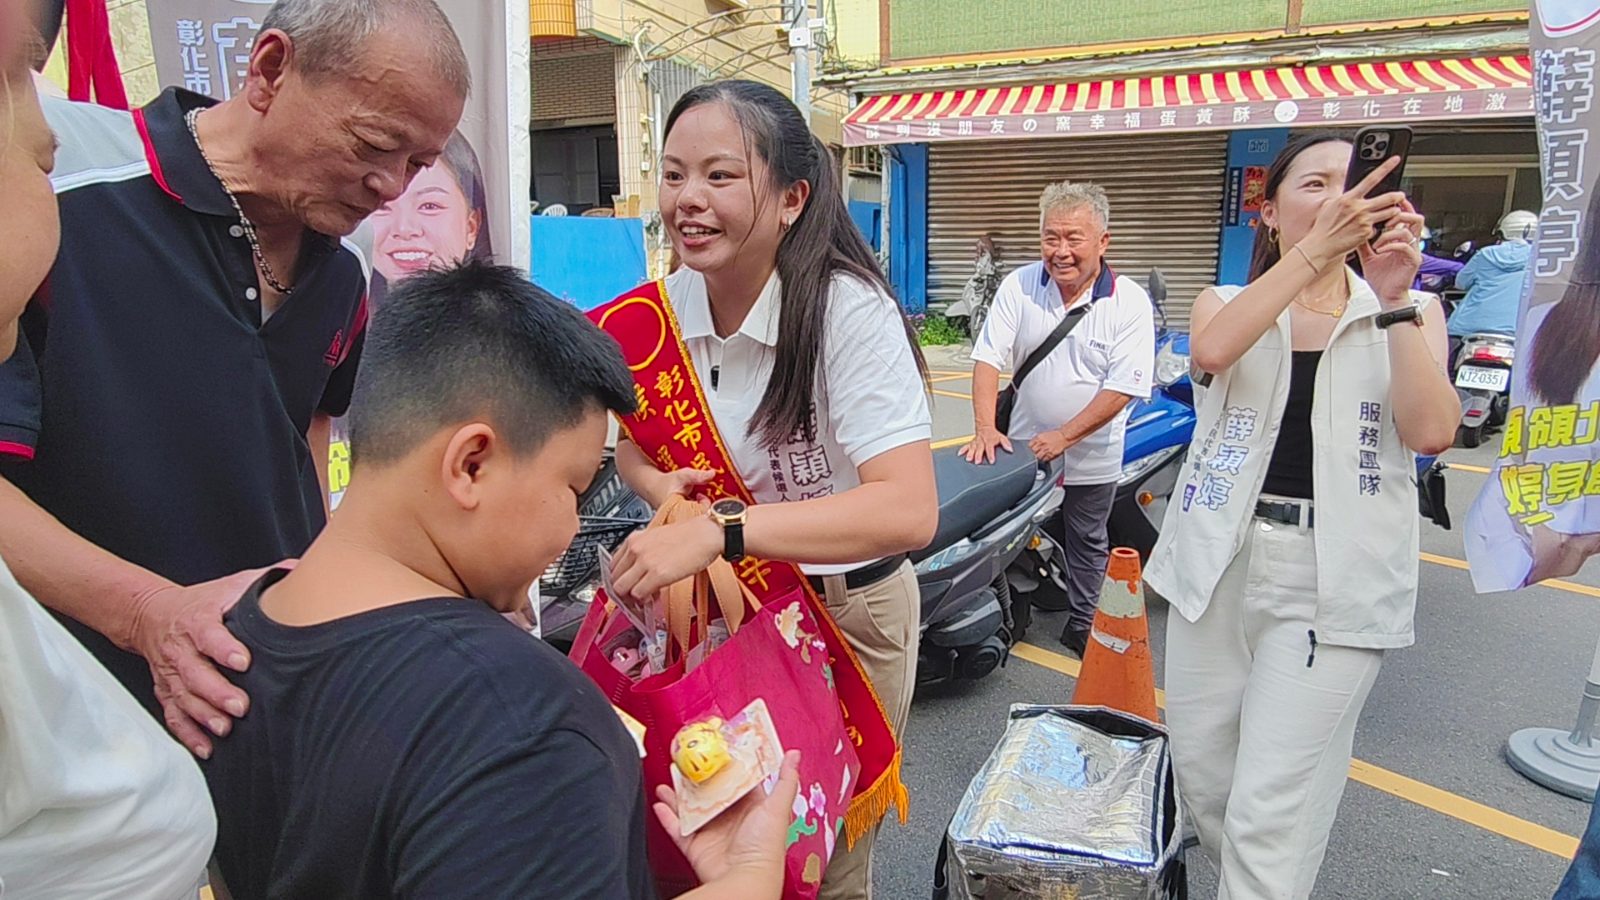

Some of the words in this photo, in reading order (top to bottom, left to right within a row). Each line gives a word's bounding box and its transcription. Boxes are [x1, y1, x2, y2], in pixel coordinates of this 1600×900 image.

[1195, 406, 1258, 511] 薛穎婷
[1358, 401, 1382, 497] 服務團隊
